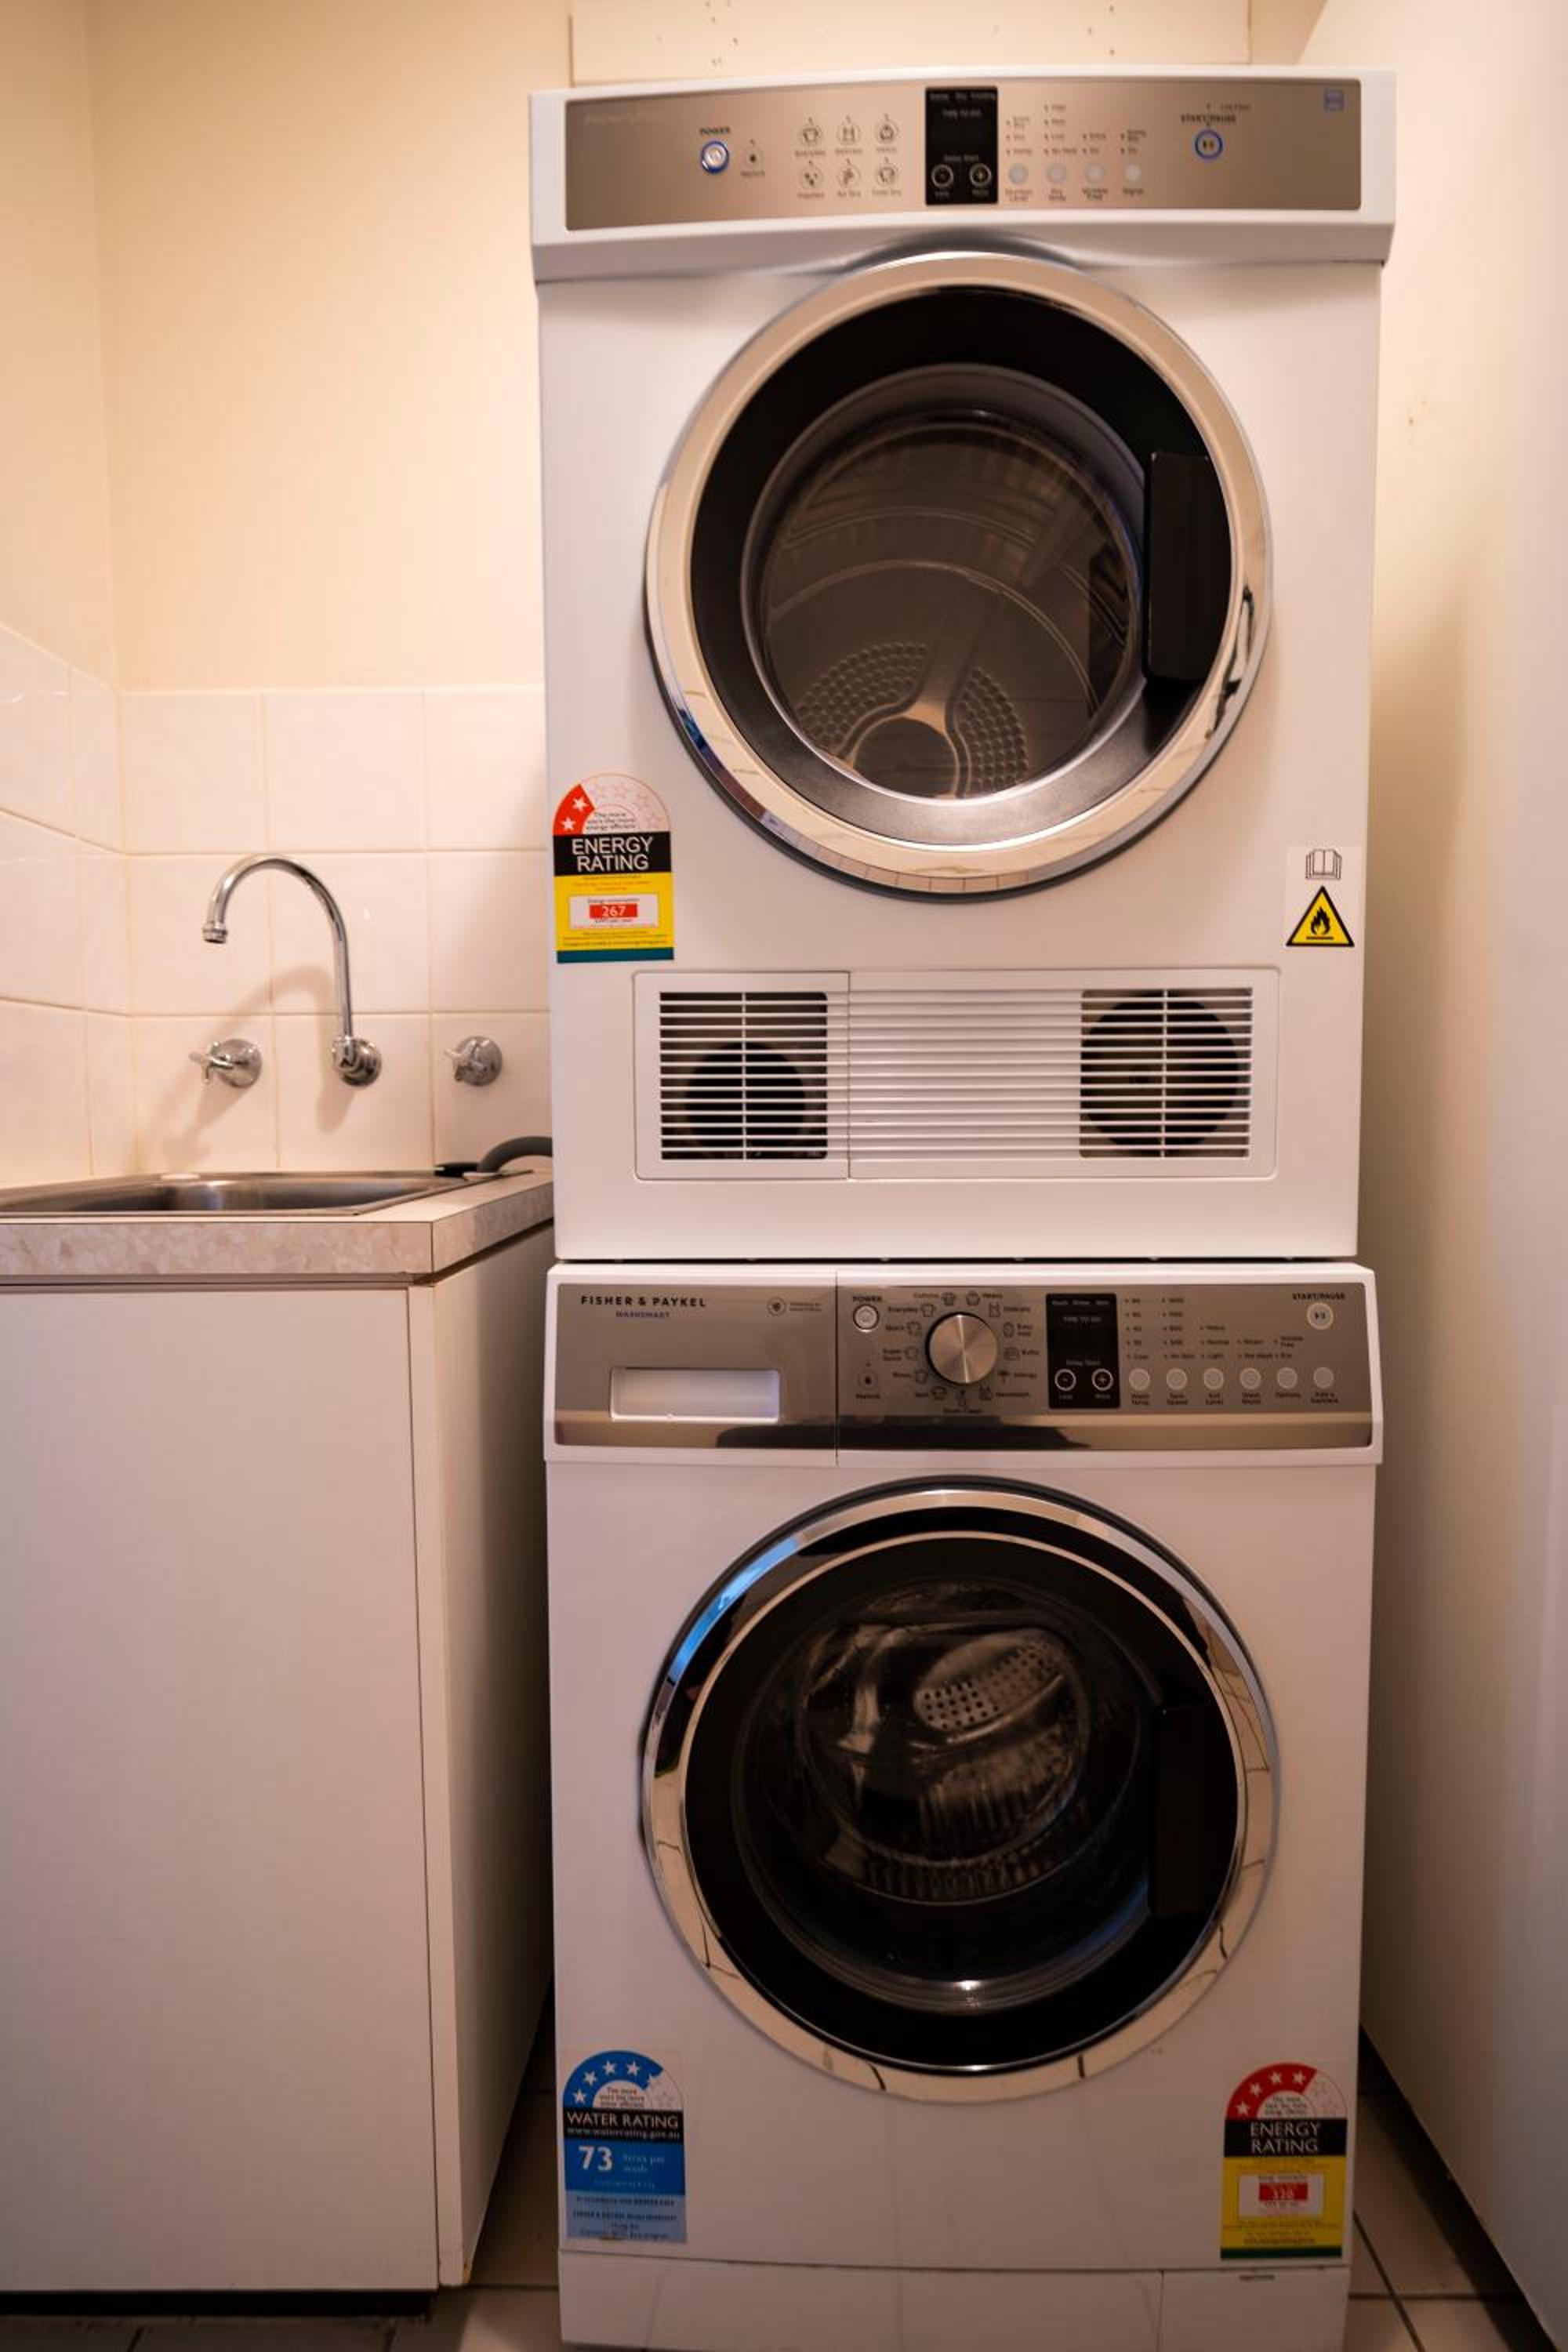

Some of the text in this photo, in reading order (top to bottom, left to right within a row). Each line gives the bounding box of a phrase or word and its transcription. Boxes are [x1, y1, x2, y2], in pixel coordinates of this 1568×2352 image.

[572, 837, 654, 855] ENERGY
[577, 854, 649, 873] RATING
[601, 905, 626, 917] 267
[581, 1295, 706, 1308] FISHER & PAYKEL
[567, 2112, 678, 2129] WATER RATING
[1250, 2122, 1322, 2137] ENERGY
[1250, 2138, 1319, 2154] RATING
[578, 2145, 614, 2172] 73
